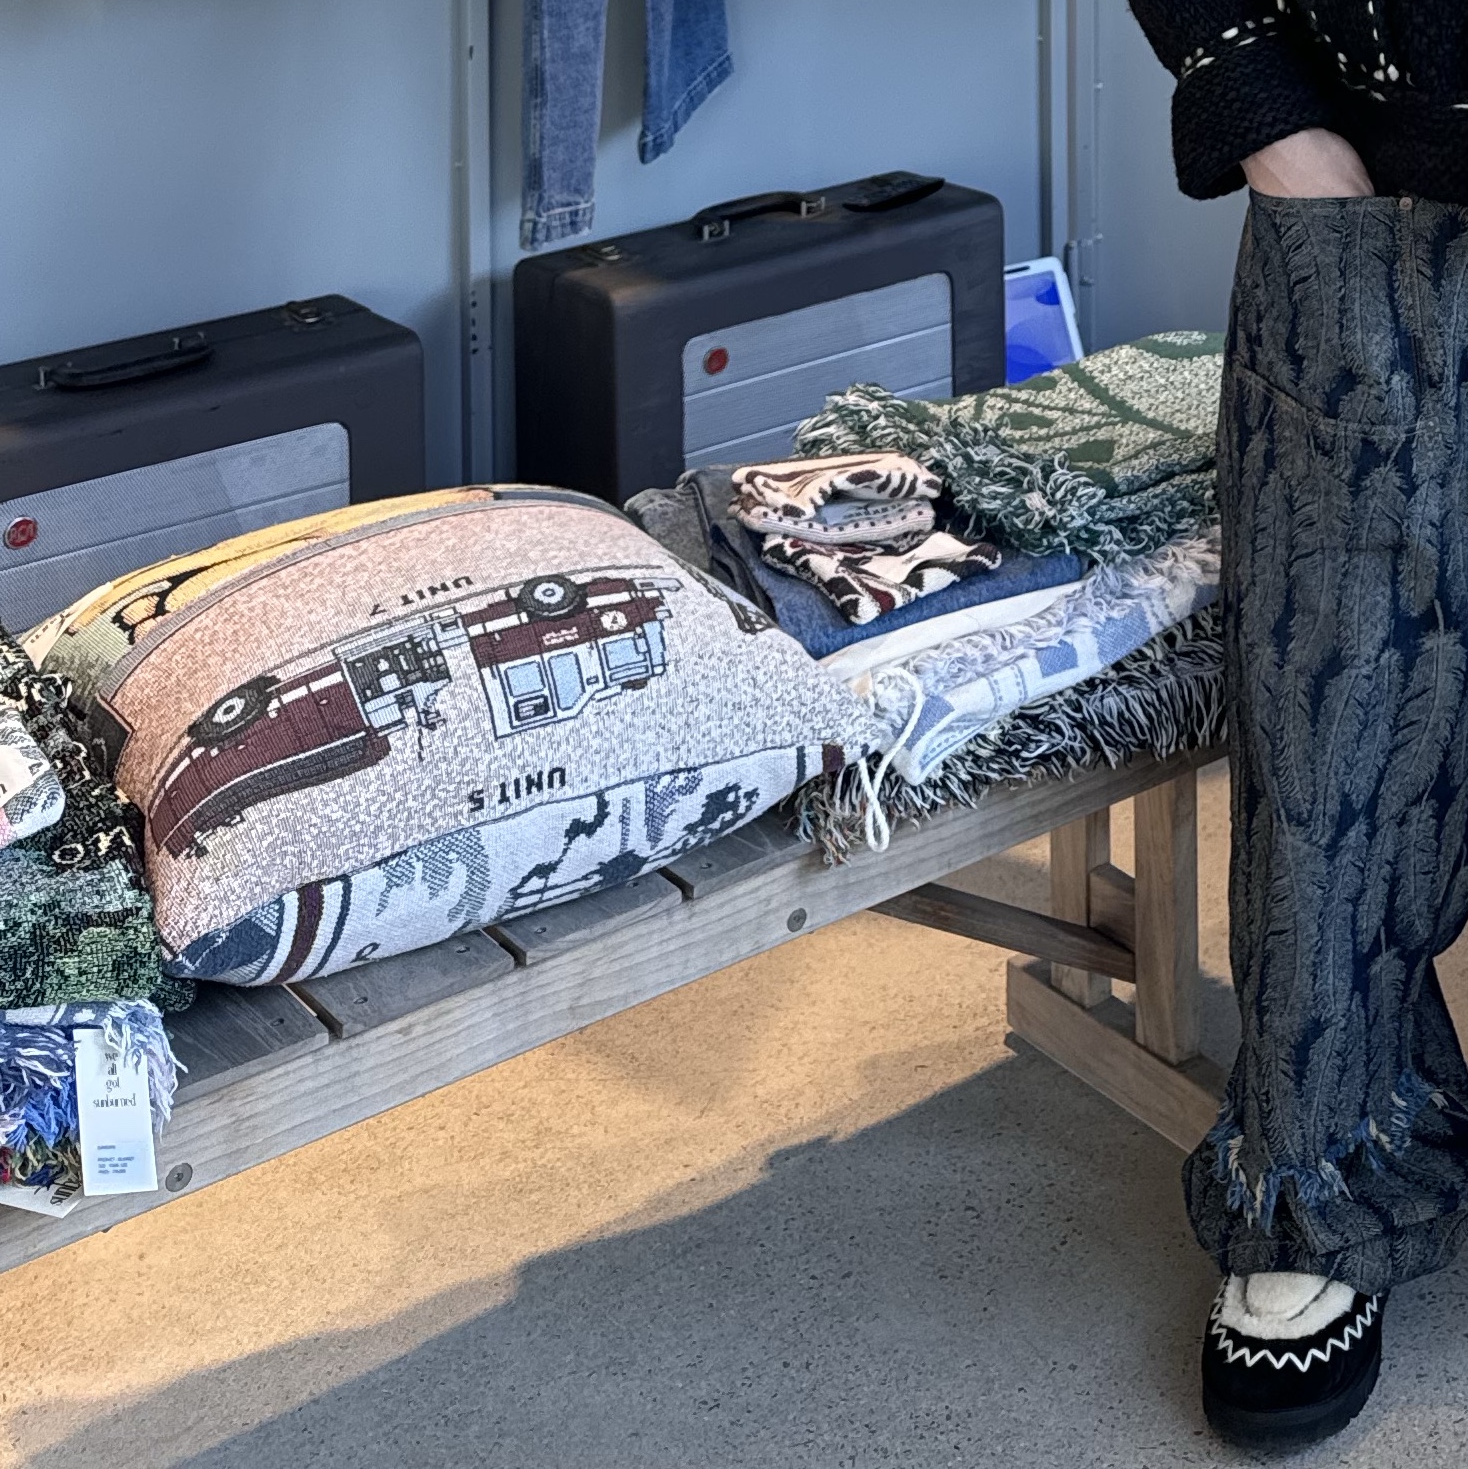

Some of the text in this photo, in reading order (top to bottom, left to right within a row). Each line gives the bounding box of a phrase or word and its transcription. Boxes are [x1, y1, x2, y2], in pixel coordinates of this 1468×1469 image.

[368, 575, 474, 617] UNIT 7
[466, 766, 566, 813] UNIT 5
